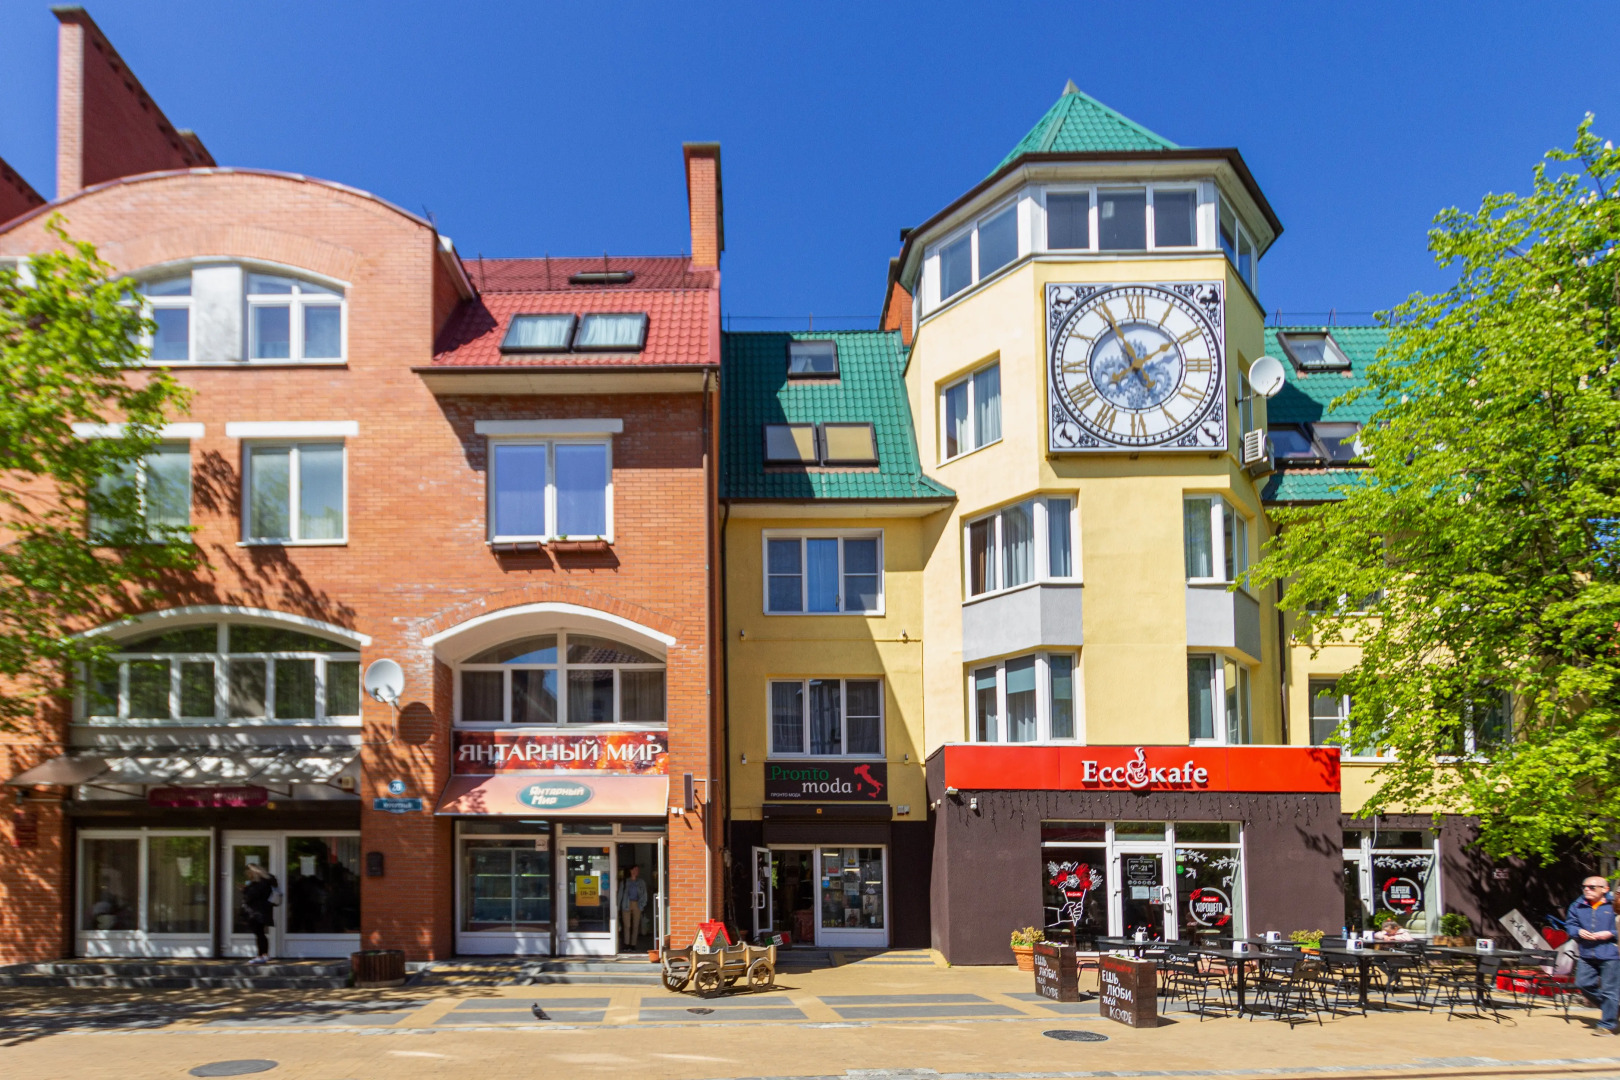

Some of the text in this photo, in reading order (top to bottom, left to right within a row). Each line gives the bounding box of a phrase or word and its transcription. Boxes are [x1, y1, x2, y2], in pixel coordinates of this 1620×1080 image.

[458, 740, 662, 761] ЯНТАРНЫЙ МИР
[771, 766, 829, 780] Pronto
[802, 778, 852, 793] moda
[1196, 903, 1222, 912] ХОРОШЕГО
[1041, 985, 1059, 999] КОФЕ
[1106, 984, 1134, 1004] ЛЮБИ,
[1109, 1006, 1133, 1024] КОФЕ
